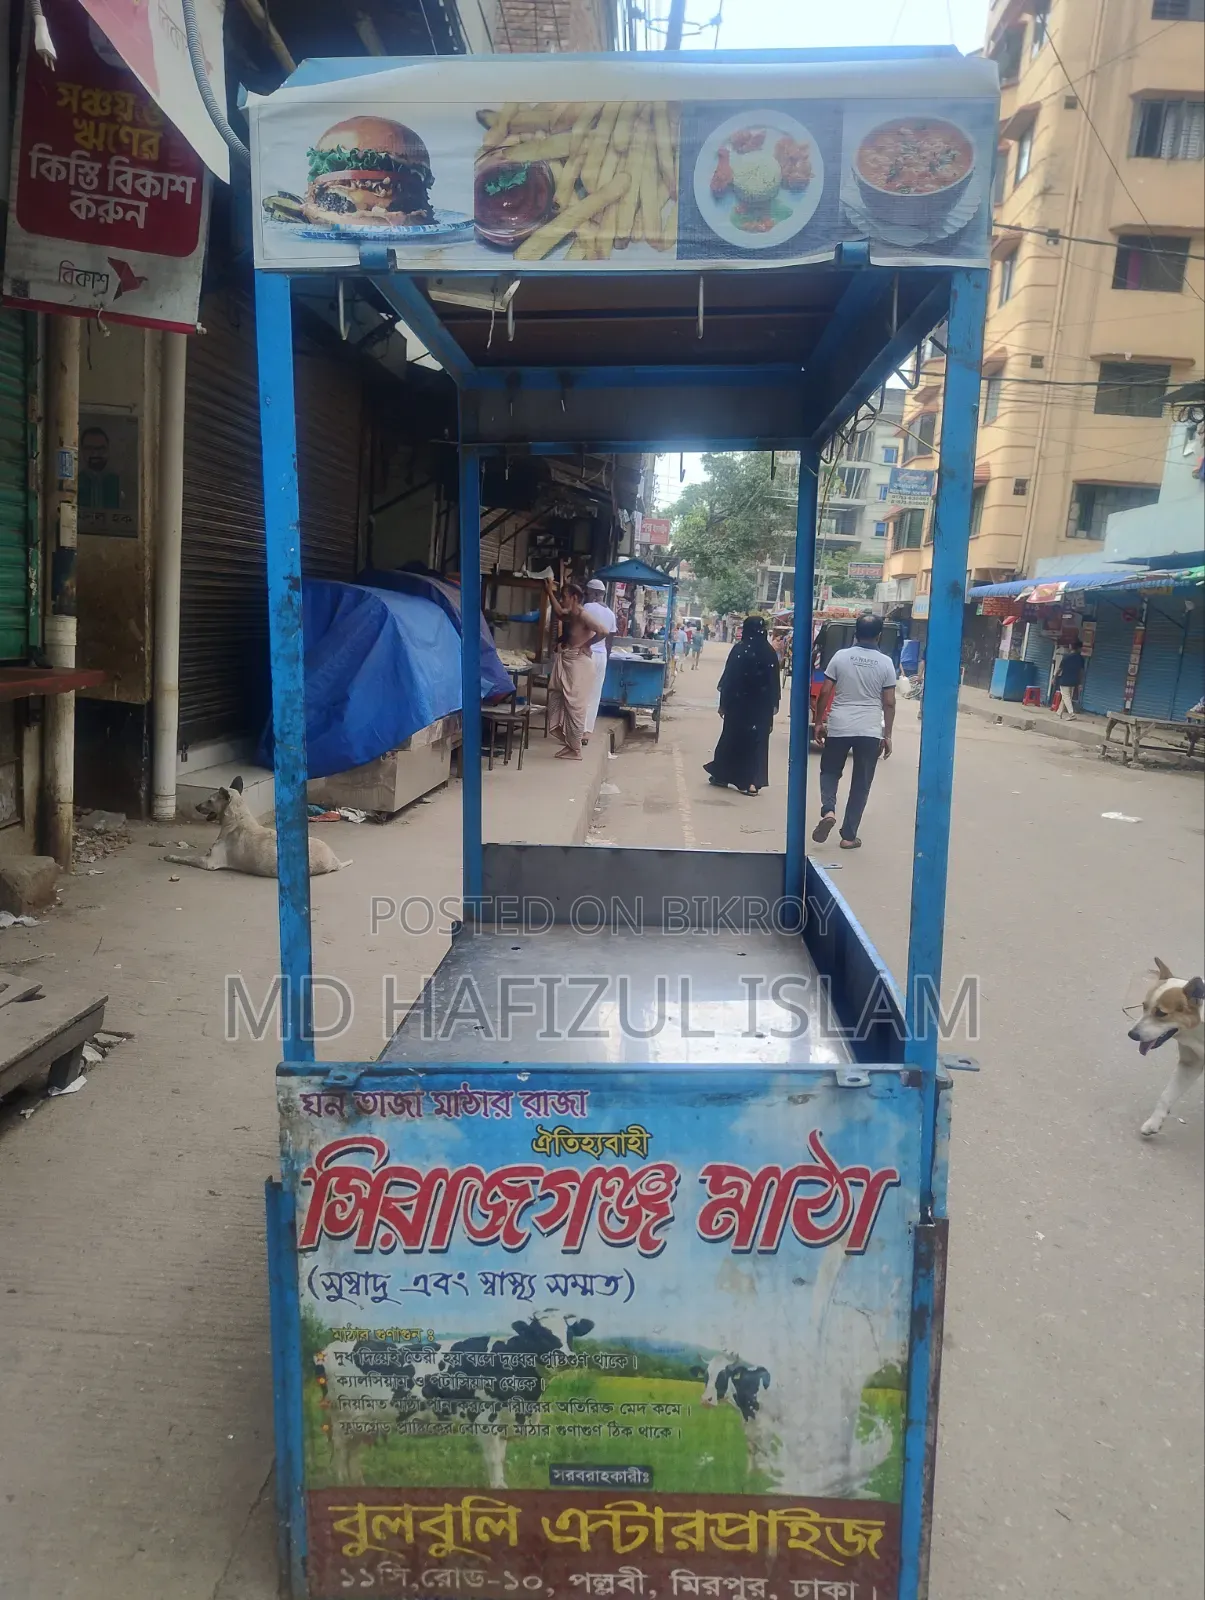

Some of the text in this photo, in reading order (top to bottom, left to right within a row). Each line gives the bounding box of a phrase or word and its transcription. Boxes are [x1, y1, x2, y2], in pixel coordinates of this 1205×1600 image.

[56, 81, 136, 122] সঞ্চয়
[73, 118, 163, 161] ঋণের
[29, 143, 196, 204] কিস্তি বিকাশ
[69, 190, 148, 229] করুন
[58, 260, 110, 293] বিকাশ
[352, 1088, 426, 1119] তাজা
[429, 1081, 514, 1119] মাঠার
[518, 1088, 590, 1119] রাজা
[531, 1124, 653, 1159] ঐতিহ্যবাহী
[297, 1128, 901, 1259] সিরাজগঞ্জ মাঠা
[400, 1271, 470, 1297] এবং
[478, 1270, 538, 1302] স্বাস্থ্য
[331, 1322, 371, 1342] মাঠার
[333, 1351, 357, 1368] দুধ
[402, 1346, 438, 1366] তৈরী
[441, 1351, 464, 1368] হয়
[335, 1370, 410, 1391] ক্যালসিয়াম
[328, 1495, 886, 1567] বুলবুলি এন্টারপ্রাইজ
